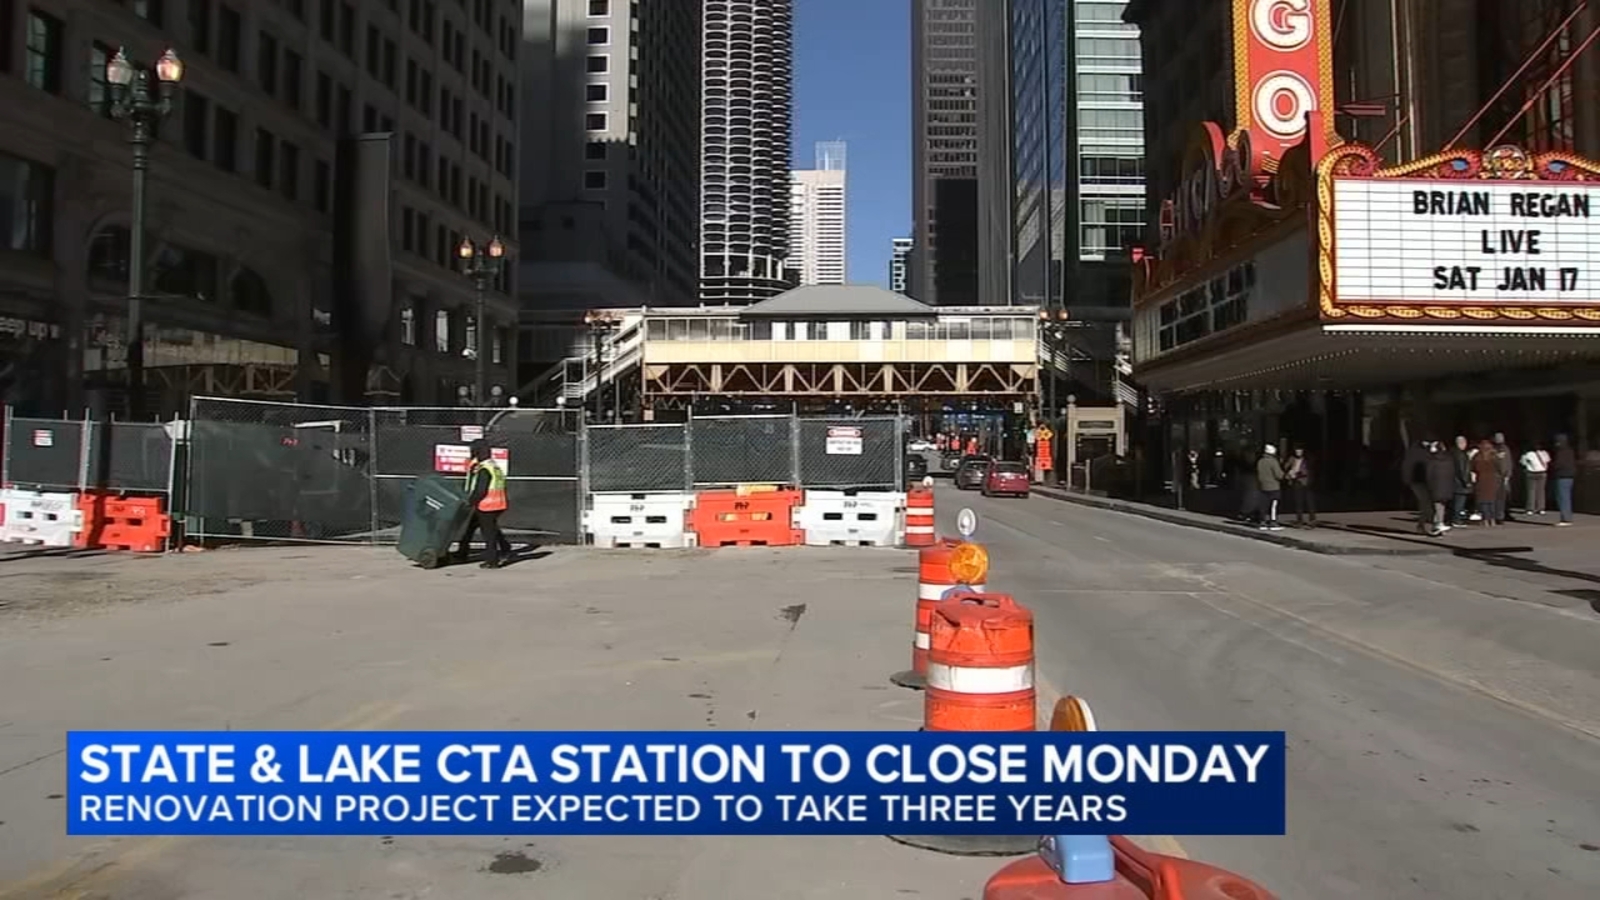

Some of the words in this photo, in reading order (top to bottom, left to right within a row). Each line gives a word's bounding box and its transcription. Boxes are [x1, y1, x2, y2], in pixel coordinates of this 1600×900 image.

[1412, 190, 1490, 216] BRIAN
[1510, 192, 1590, 218] REGAN
[1481, 229, 1541, 255] LIVE
[1433, 265, 1481, 291] SAT
[1496, 266, 1546, 292] JAN
[1559, 267, 1578, 292] 17
